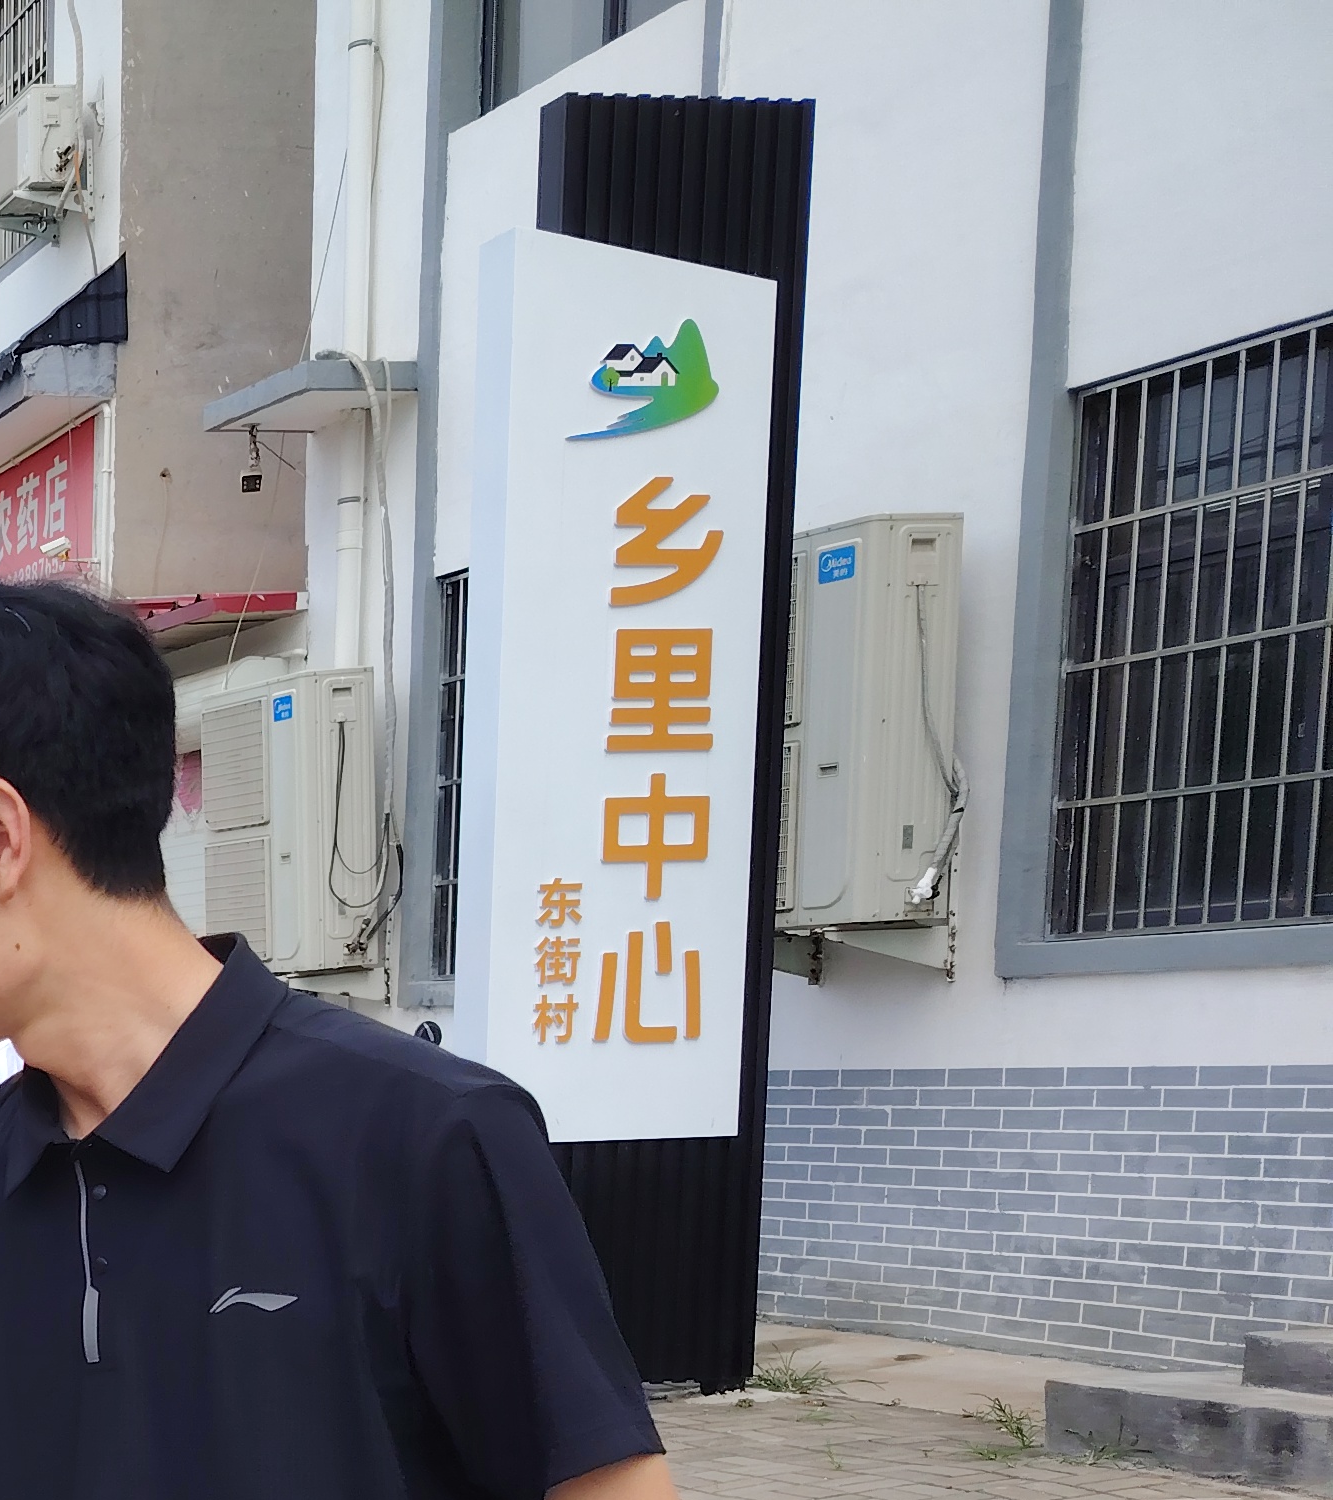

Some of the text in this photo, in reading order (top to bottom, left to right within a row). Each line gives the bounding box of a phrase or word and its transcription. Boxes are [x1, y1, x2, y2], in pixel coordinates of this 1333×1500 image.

[591, 476, 725, 1045] 乡里中心
[533, 877, 584, 1045] 东街村
